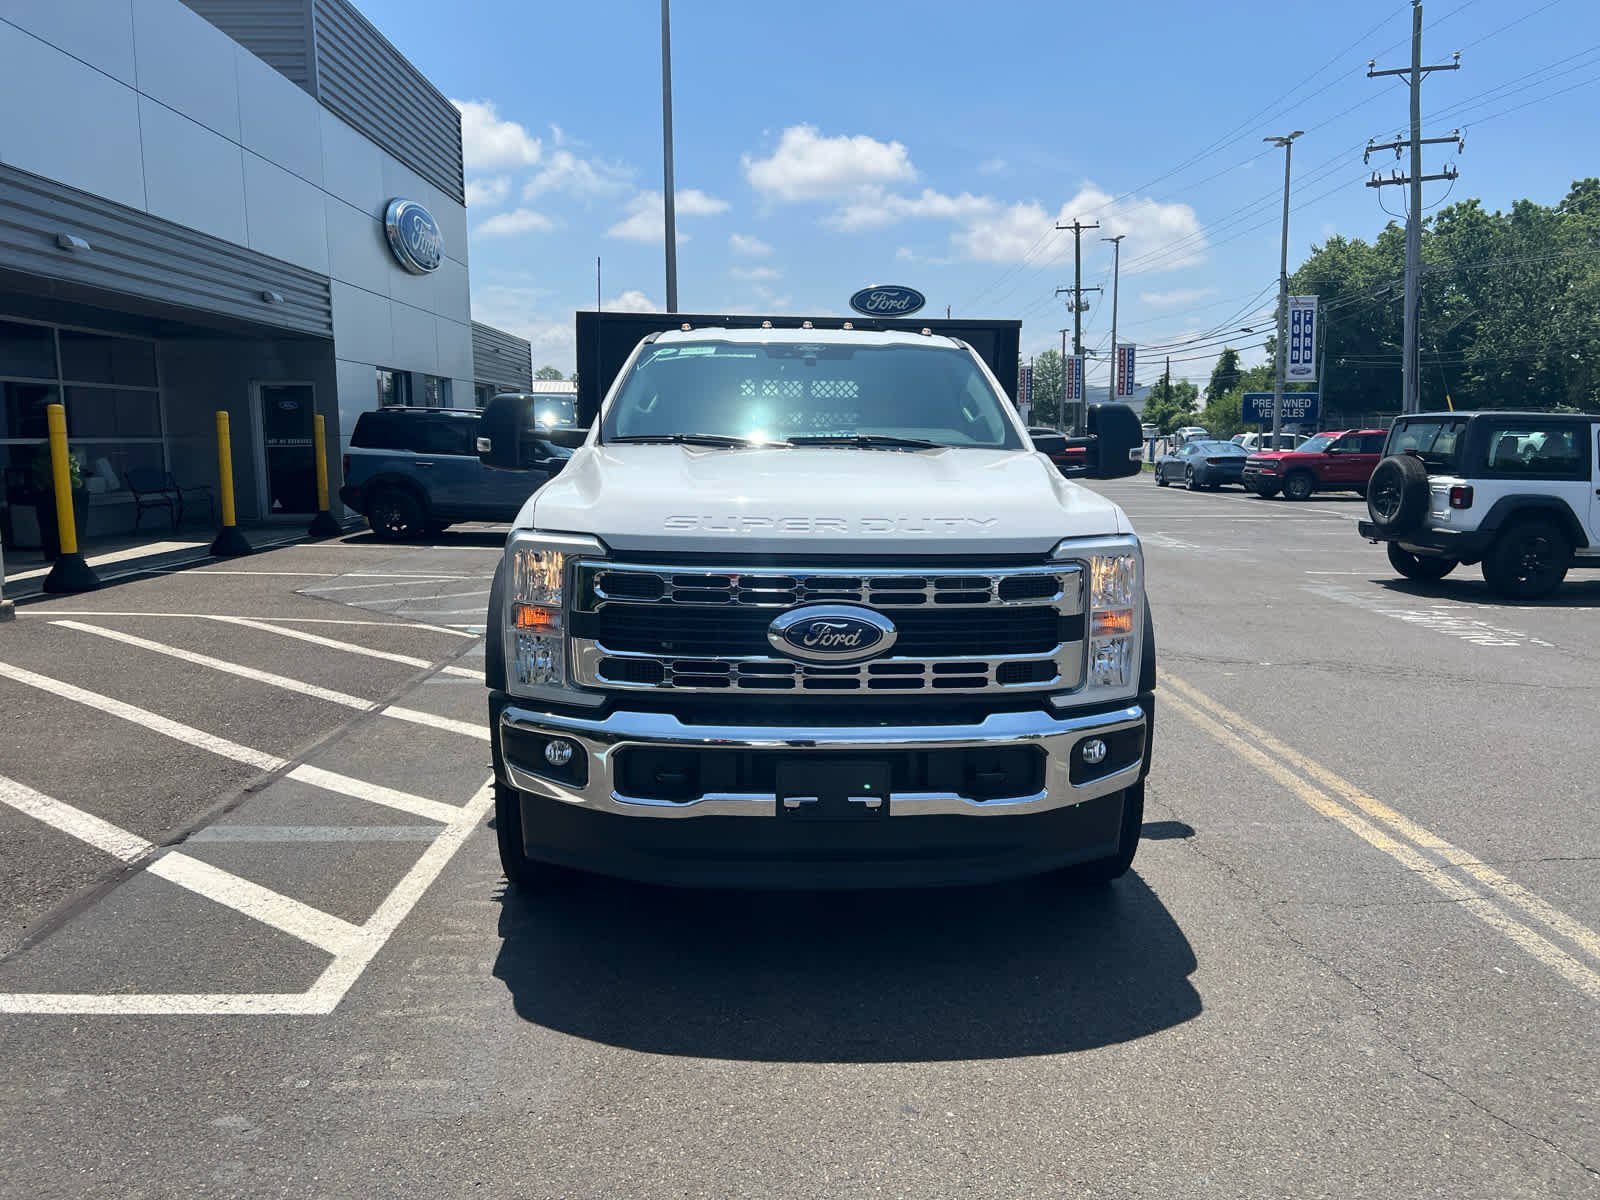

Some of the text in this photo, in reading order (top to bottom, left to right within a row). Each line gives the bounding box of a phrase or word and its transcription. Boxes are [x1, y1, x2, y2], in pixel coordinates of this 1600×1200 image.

[411, 215, 441, 258] Ford
[866, 291, 911, 310] Ford
[1292, 311, 1300, 361] FORD
[1304, 311, 1312, 361] FORD
[1252, 399, 1312, 409] PRE-WNED
[1258, 408, 1305, 418] VEHCLES
[664, 515, 999, 534] SUPER DUTY
[803, 622, 863, 646] Ford
